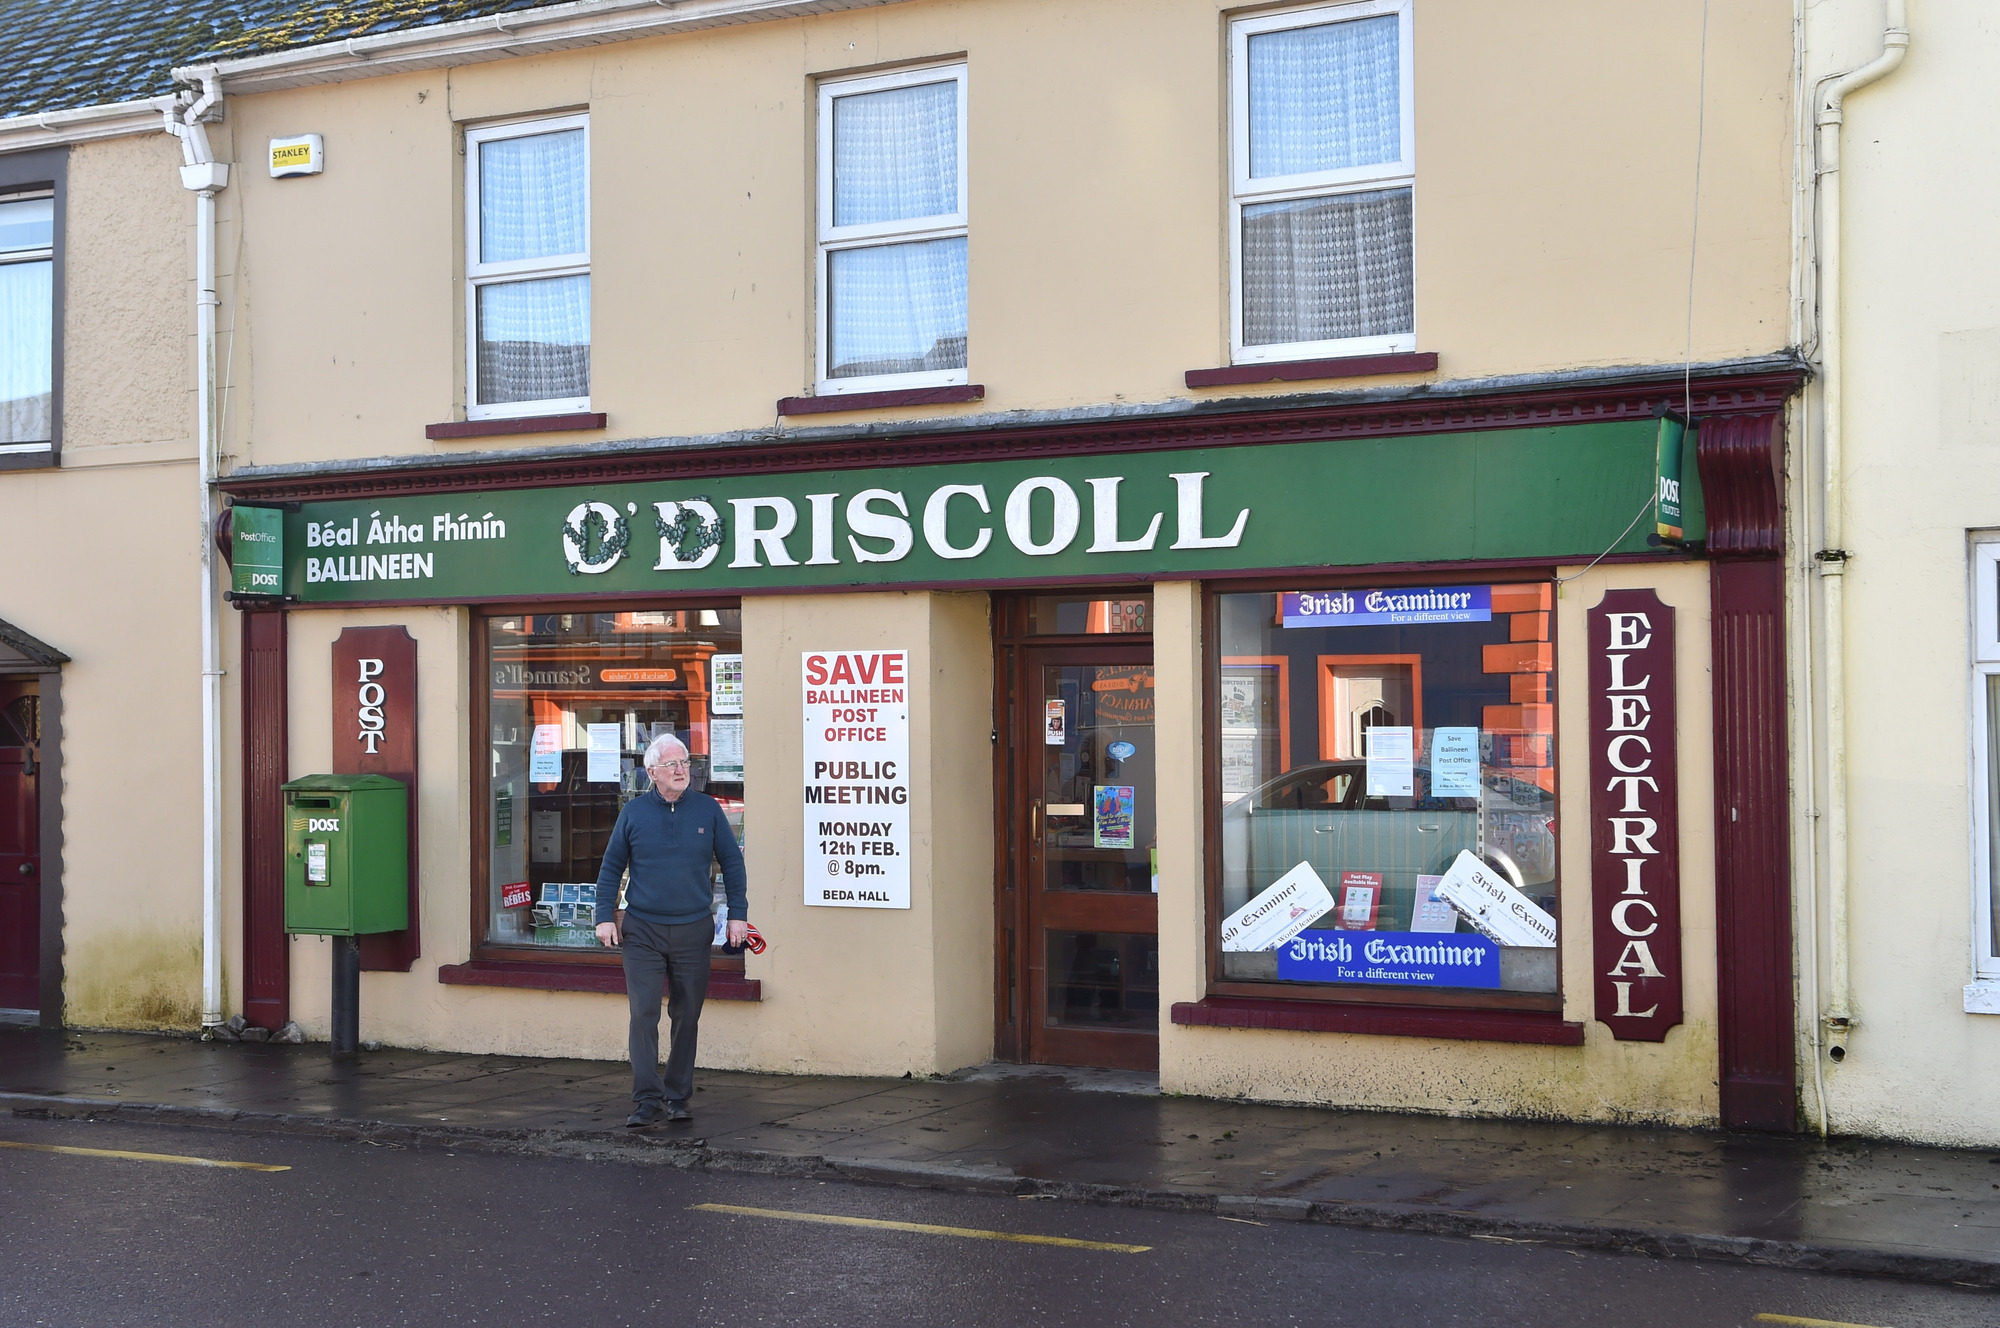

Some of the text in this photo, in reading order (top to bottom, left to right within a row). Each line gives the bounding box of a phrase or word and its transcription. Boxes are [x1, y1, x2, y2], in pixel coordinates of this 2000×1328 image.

[272, 147, 309, 160] STANLEY
[1660, 476, 1679, 503] post
[307, 510, 506, 548] Béal Átha Fhínín
[562, 471, 1249, 576] O'DRISCOLL
[306, 552, 434, 583] BALLINEEN
[252, 573, 278, 586] post
[1299, 589, 1471, 615] Irish Examiner
[1391, 613, 1405, 622] For
[1414, 612, 1448, 621] different
[1450, 611, 1471, 620] view
[806, 654, 904, 686] SAVE
[358, 658, 385, 754] POST
[806, 689, 904, 705] BALLINEEN
[832, 708, 877, 722] POST
[824, 727, 887, 742] OFFICE
[814, 761, 897, 780] PUBLIC
[805, 786, 907, 805] MEETING
[1605, 612, 1666, 1018] ELECTRICAL
[309, 818, 340, 833] post
[819, 821, 893, 837] MONDAY
[819, 840, 900, 857] 12th FEB.
[827, 860, 885, 878] @ 8pm.
[823, 889, 890, 902] BEDA HALL
[1472, 871, 1507, 903] Irish
[503, 890, 532, 908] REBELS
[1241, 882, 1297, 927] Examiner
[1278, 924, 1299, 943] World
[1289, 936, 1486, 967] Irish Examiner
[1337, 966, 1435, 981] For a different view
